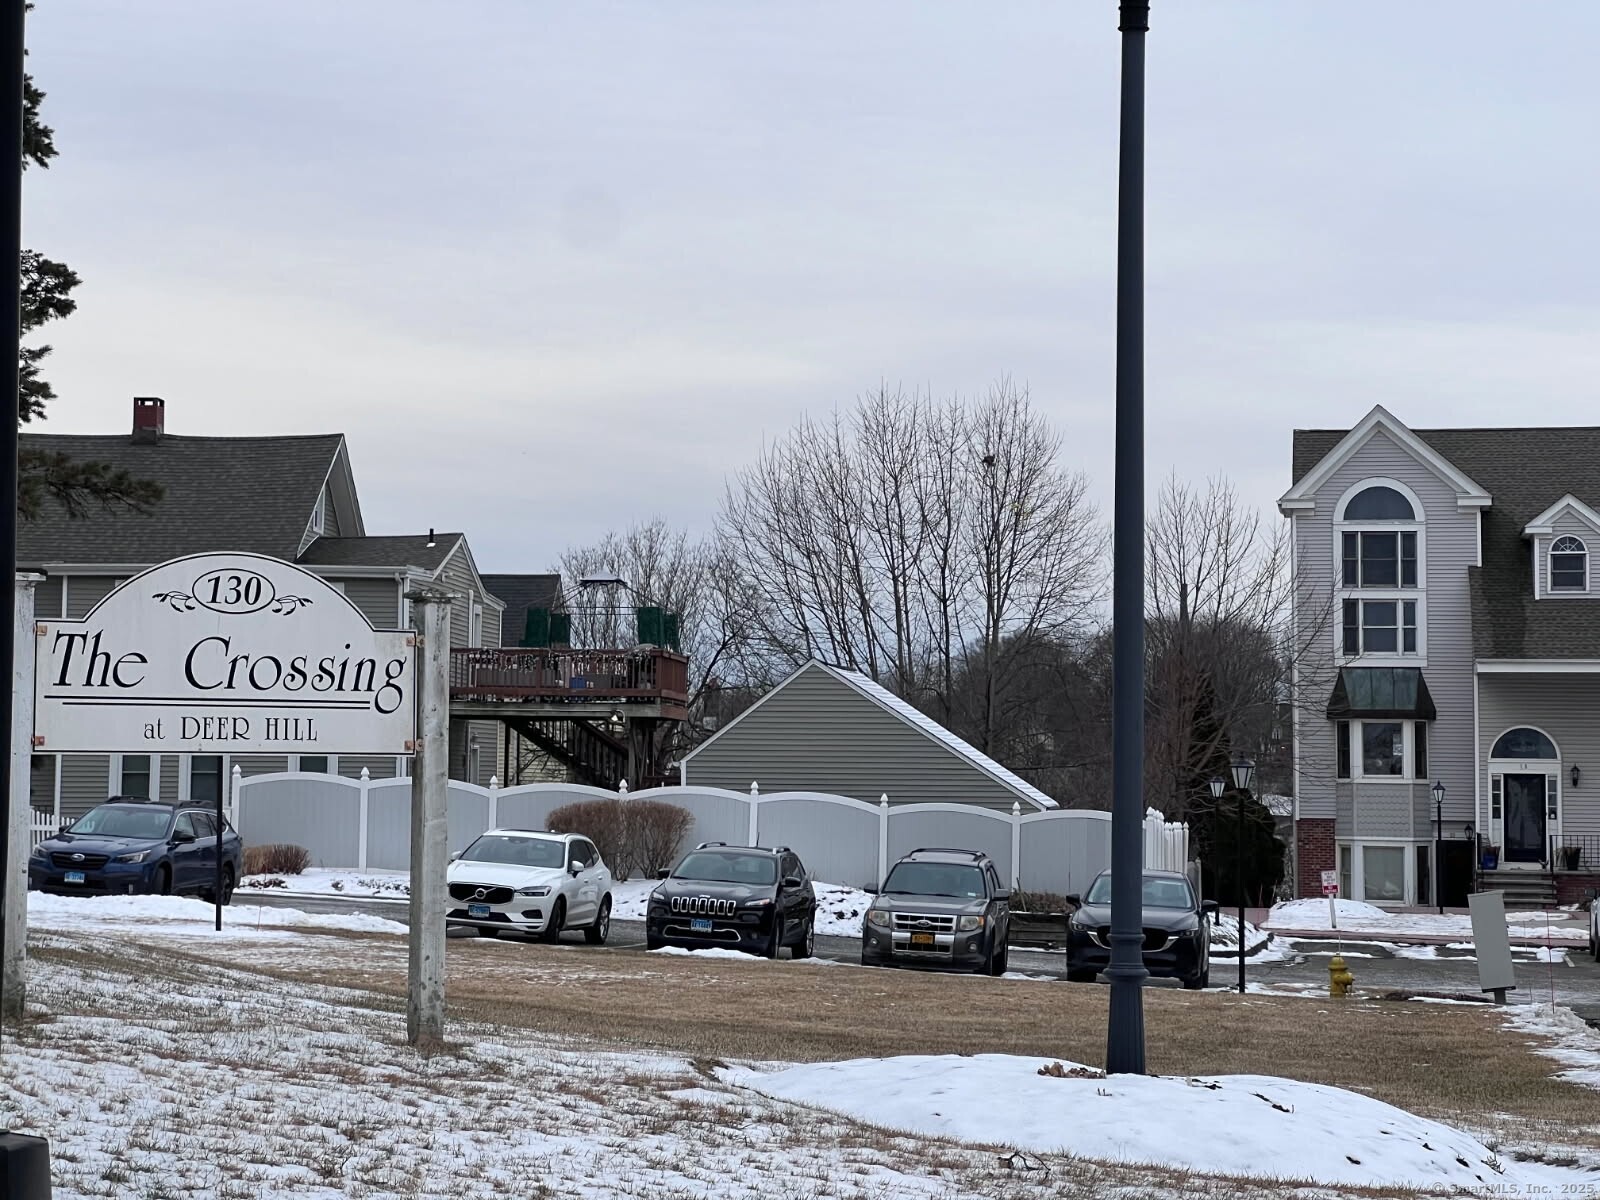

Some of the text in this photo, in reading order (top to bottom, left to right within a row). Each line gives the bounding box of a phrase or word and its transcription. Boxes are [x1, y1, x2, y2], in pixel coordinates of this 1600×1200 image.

[206, 576, 262, 605] 130
[52, 629, 408, 715] The Crossing
[143, 717, 318, 741] at DEER HILL
